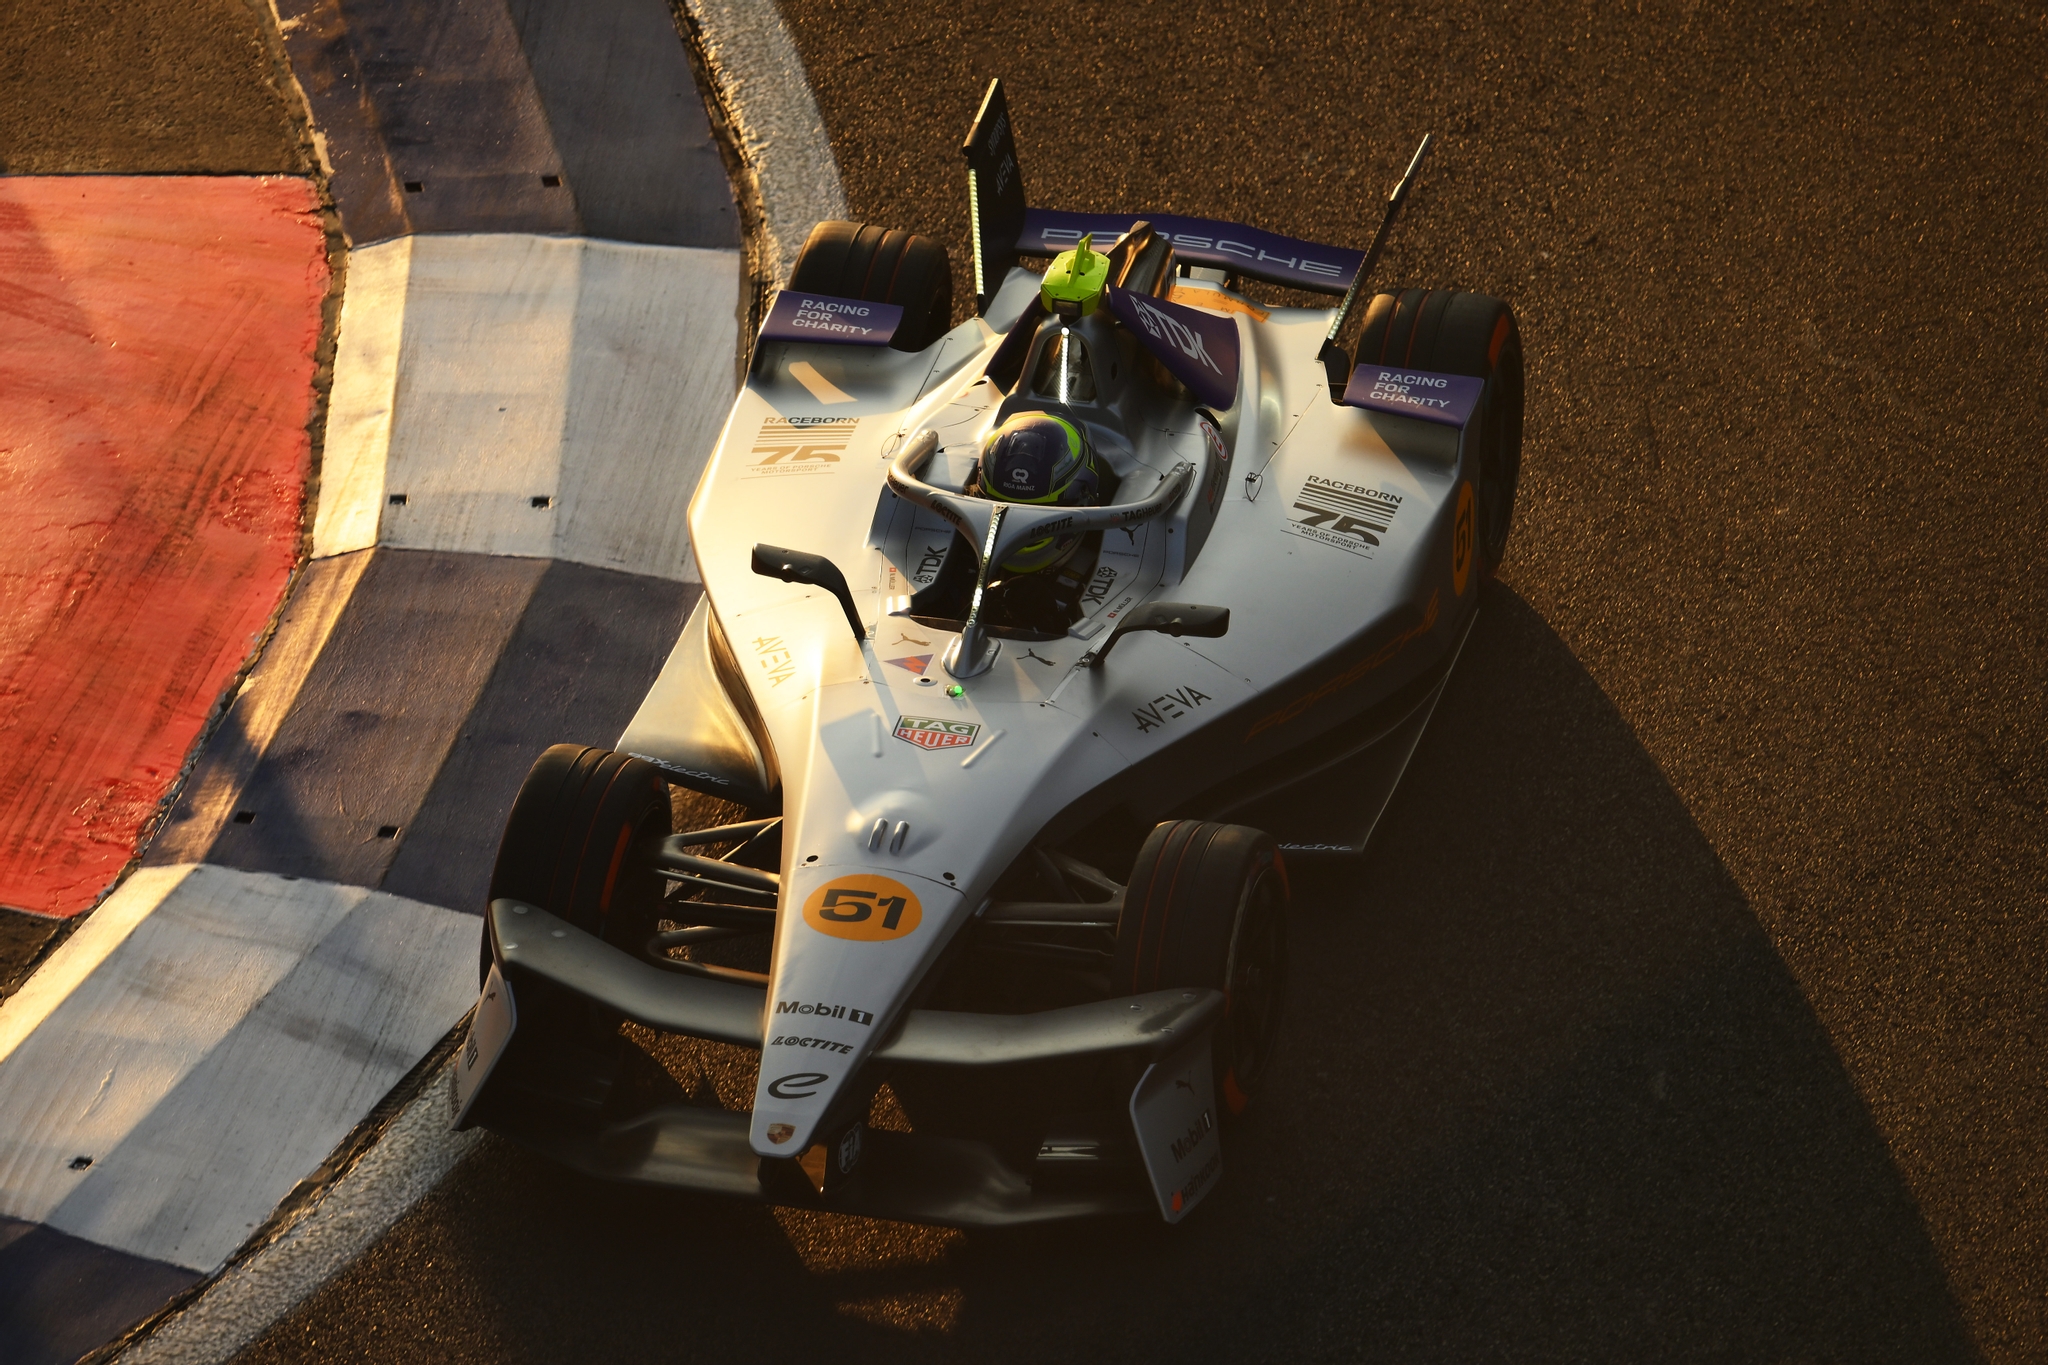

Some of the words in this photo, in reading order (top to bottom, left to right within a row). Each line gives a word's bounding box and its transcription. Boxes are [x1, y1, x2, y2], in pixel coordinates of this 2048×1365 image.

[796, 309, 833, 322] FOR
[800, 299, 870, 317] RACING
[792, 318, 872, 335] CHARITY
[1141, 301, 1223, 376] TDK
[1374, 382, 1410, 394] FOR
[1378, 372, 1448, 388] RACING
[1369, 391, 1450, 408] CHARITY
[763, 416, 860, 424] RACEBORN
[751, 444, 841, 466] 75
[760, 467, 818, 475] MOTORSPORT
[1003, 481, 1015, 490] RIGA
[1307, 474, 1403, 504] RACEBORN
[930, 500, 963, 526] LOCTITE
[914, 526, 952, 534] PORSCHE
[1030, 516, 1073, 539] LOCTITE
[1293, 502, 1387, 547] 75
[1291, 523, 1319, 535] YEARS
[1332, 535, 1371, 551] PORSCHE
[1300, 530, 1358, 550] MOTORSPORT
[916, 545, 948, 575] TDK
[1102, 550, 1140, 558] PORSCHE
[1082, 578, 1115, 606] TDK
[752, 636, 796, 688] AVEVA
[1131, 685, 1212, 734] AVEVA
[907, 718, 970, 735] TAG
[900, 729, 969, 747] HEUER
[818, 888, 907, 931] 51
[775, 1001, 846, 1020] Mobil
[771, 1035, 854, 1055] LOCTITE
[1170, 1119, 1206, 1163] Mobil
